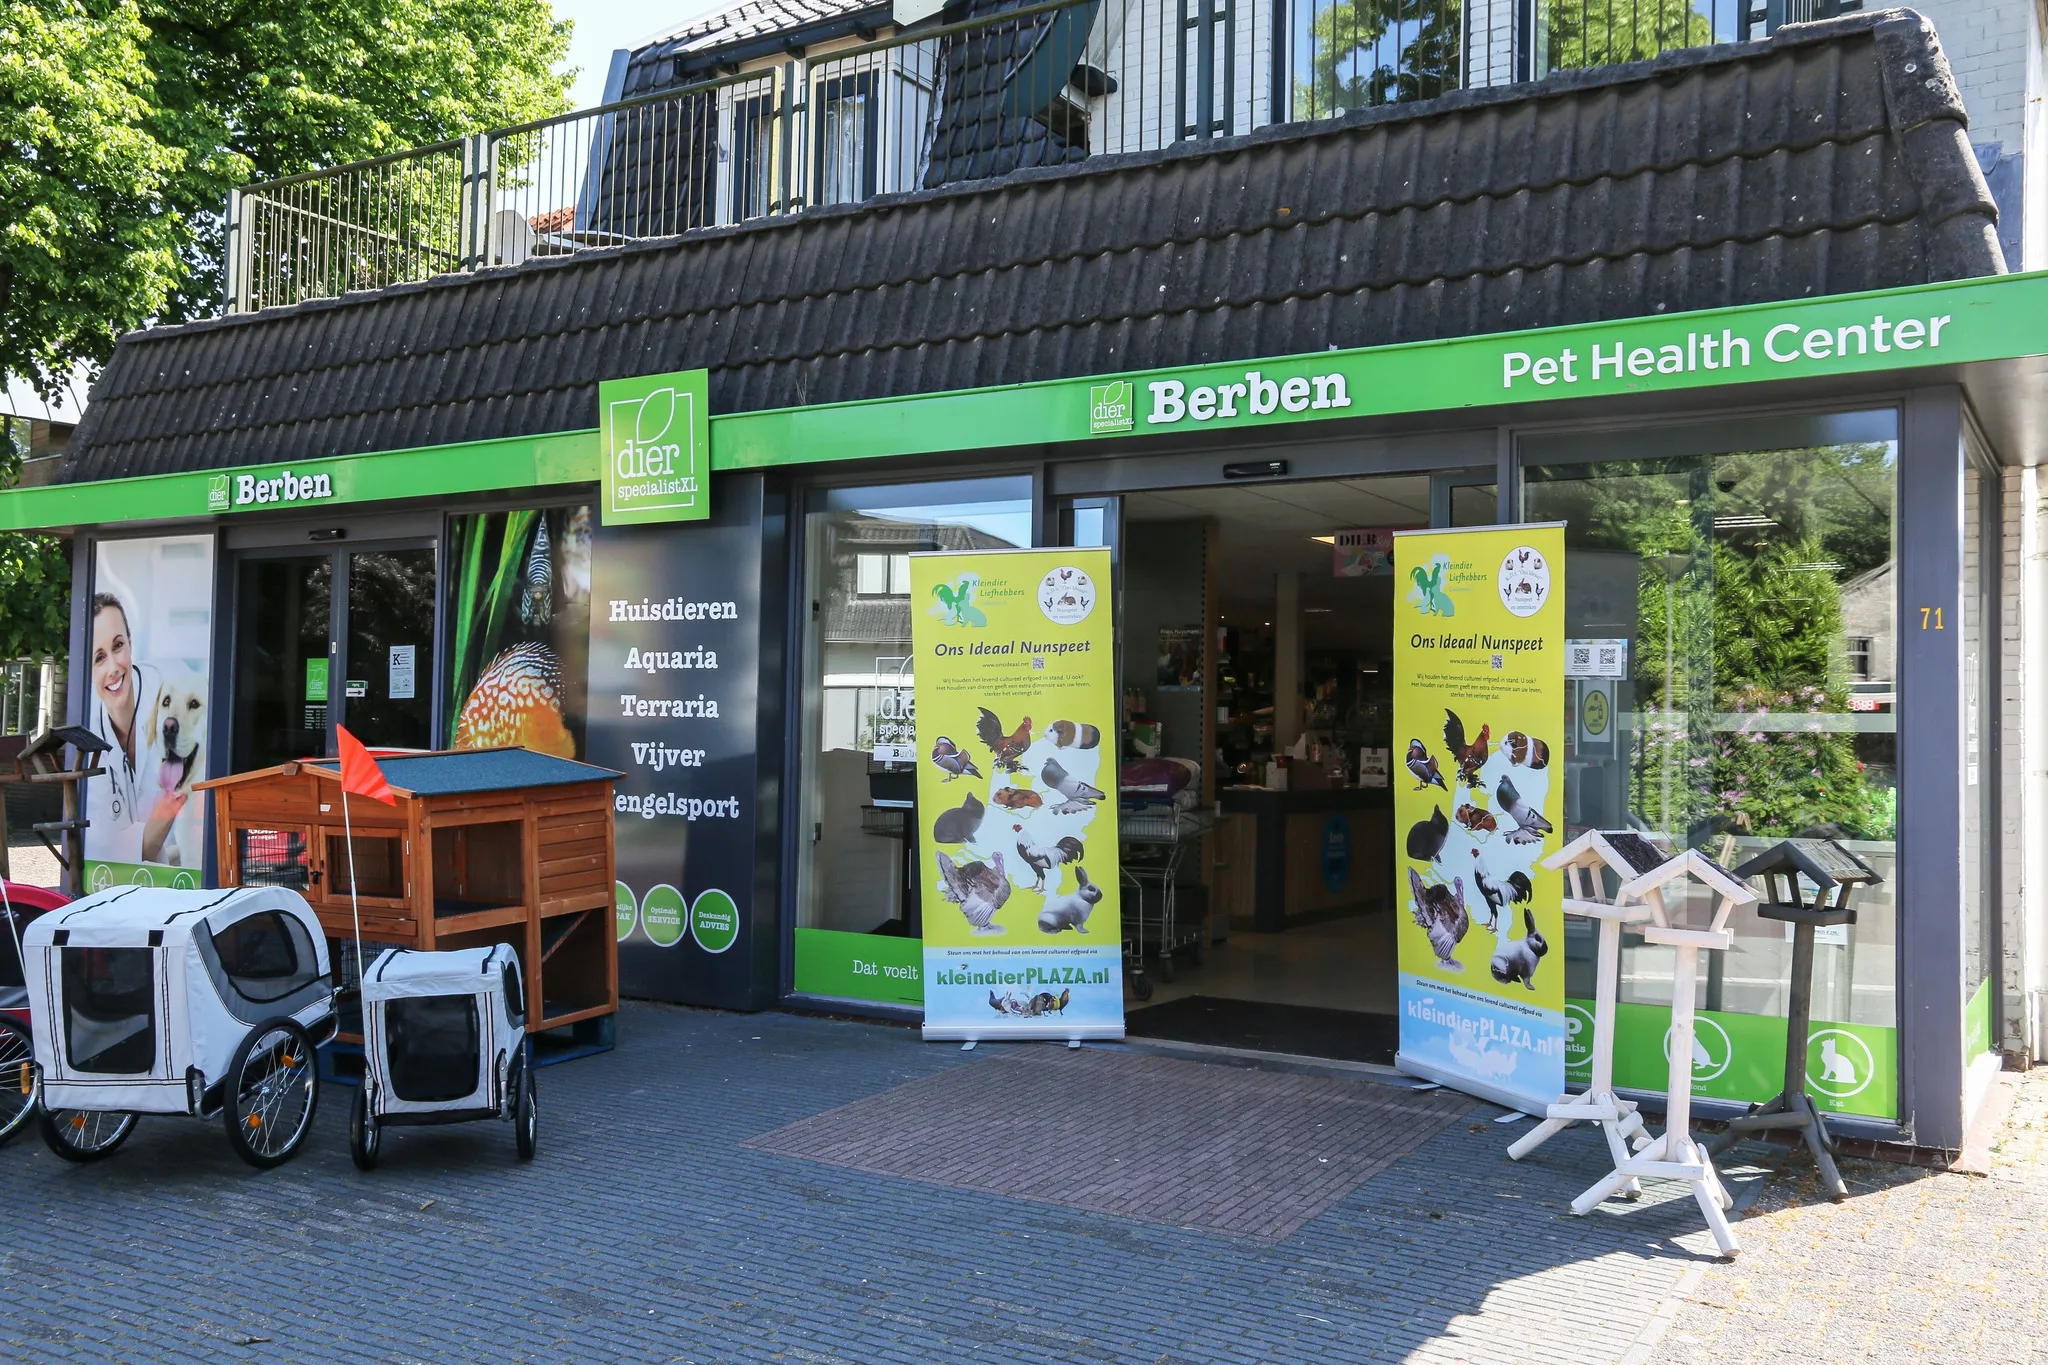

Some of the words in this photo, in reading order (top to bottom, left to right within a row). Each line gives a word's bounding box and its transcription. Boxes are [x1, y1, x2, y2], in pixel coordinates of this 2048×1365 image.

[1503, 347, 1577, 388] Pet
[1591, 328, 1751, 380] Health
[1763, 314, 1951, 364] Center
[1147, 371, 1351, 424] Berben
[1093, 402, 1126, 419] dier
[1093, 417, 1135, 428] specialistXL
[617, 439, 680, 479] dier
[209, 488, 226, 501] dier
[236, 470, 332, 505] Berben
[618, 476, 698, 500] specialistXL
[1442, 561, 1473, 570] Kleindier
[972, 579, 1008, 587] Kleindier
[1449, 572, 1487, 584] Liefhebbers
[980, 588, 1025, 598] Liefhebbers
[608, 597, 738, 622] Huisdieren
[1920, 607, 1944, 630] 71
[934, 643, 964, 656] Ons
[969, 640, 1015, 655] Ideaal
[1020, 640, 1091, 656] Nunspeet
[1411, 634, 1435, 649] Ons
[1439, 633, 1477, 650] Ideaal
[1481, 635, 1543, 655] Nunspeet
[623, 645, 718, 674] Aquaria
[620, 694, 719, 718] Terraria
[880, 688, 916, 720] die
[879, 723, 916, 738] specia
[630, 741, 705, 772] Vijver
[613, 790, 740, 821] engelsport
[647, 915, 680, 925] SERVICE
[650, 906, 678, 914] Optimale
[698, 911, 731, 922] Deskundig
[699, 921, 730, 931] ADVIES
[852, 959, 878, 975] Dat
[883, 965, 918, 980] voelt
[937, 967, 1110, 985] kleindierPLAZA.nl
[1416, 979, 1428, 987] Steun
[1452, 988, 1467, 998] behoud
[1484, 997, 1498, 1006] levend
[1499, 1001, 1518, 1010] cultureel
[1518, 1006, 1534, 1015] erfgoed
[1407, 1000, 1553, 1056] kleindierPLAZA.nl
[1564, 1017, 1583, 1042] P
[1565, 1043, 1586, 1053] atis
[1828, 1099, 1845, 1107] Kat
